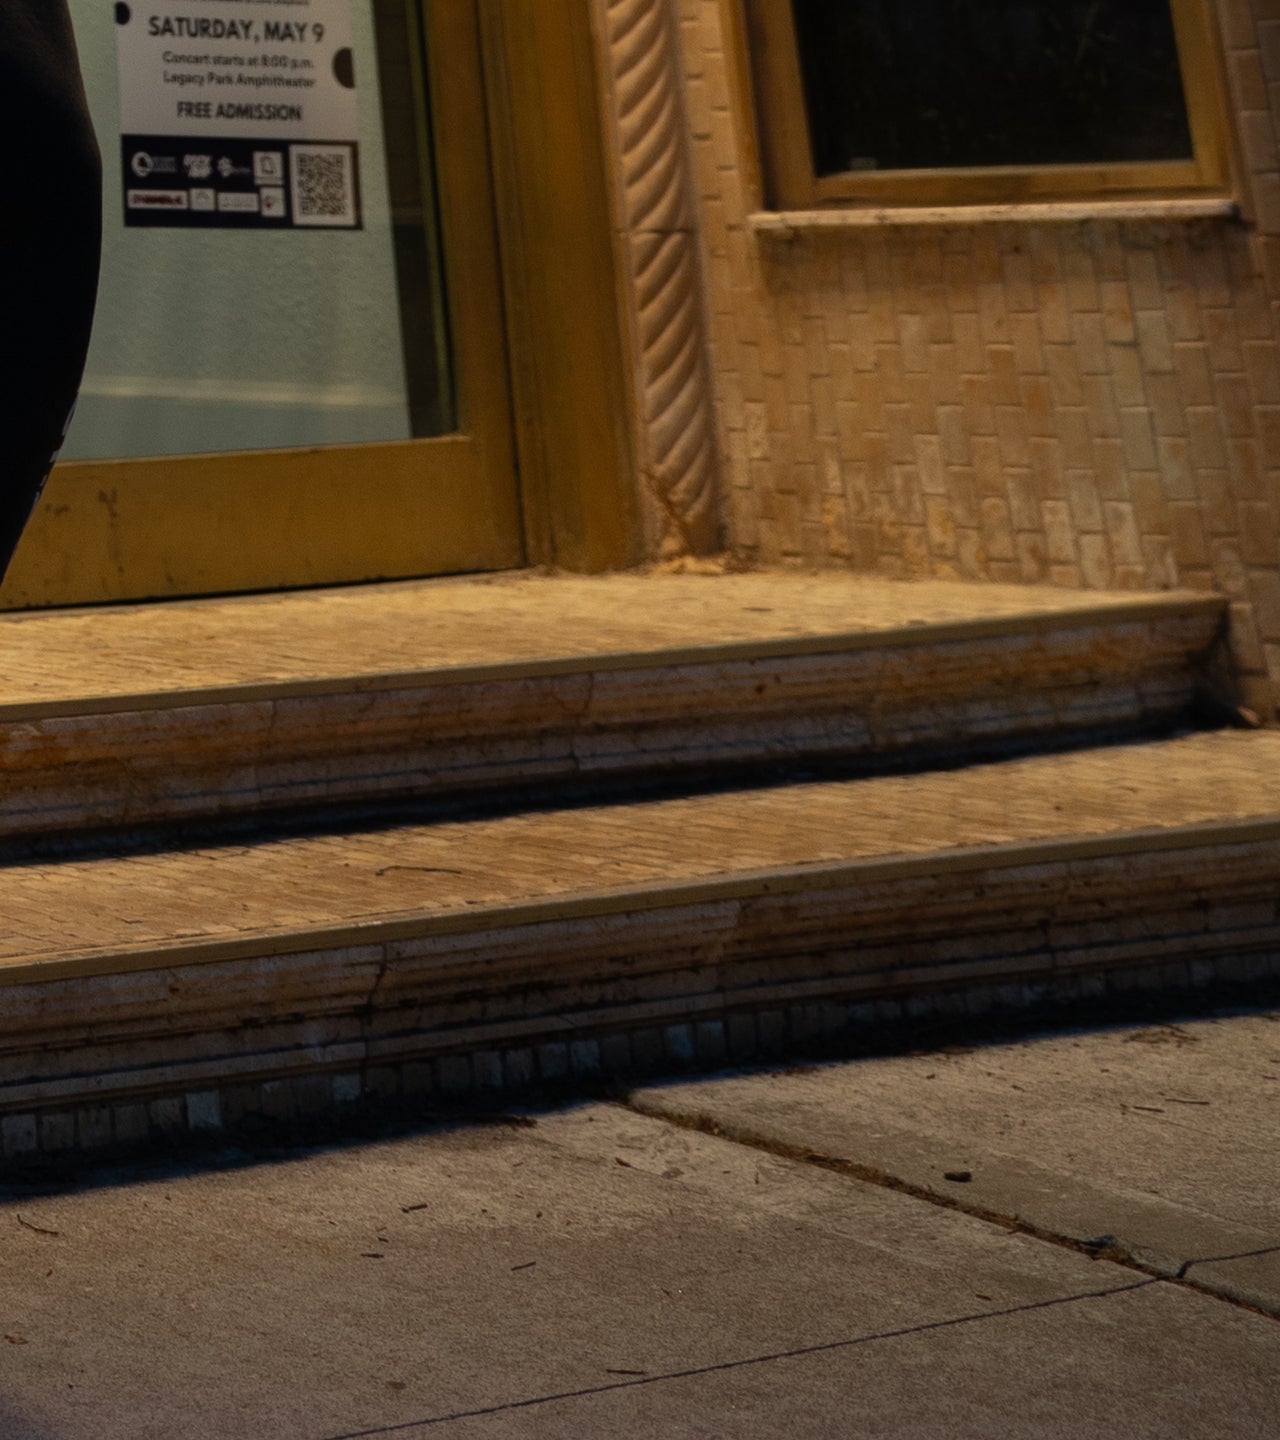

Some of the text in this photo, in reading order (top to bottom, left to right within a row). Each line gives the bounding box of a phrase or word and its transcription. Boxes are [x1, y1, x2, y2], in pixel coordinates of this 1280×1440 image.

[148, 15, 325, 44] SATURDAY, MAY 9
[162, 50, 210, 66] Concert
[162, 70, 204, 88] Legacy
[207, 71, 234, 86] Park
[176, 100, 303, 121] FREE ADMISSION
